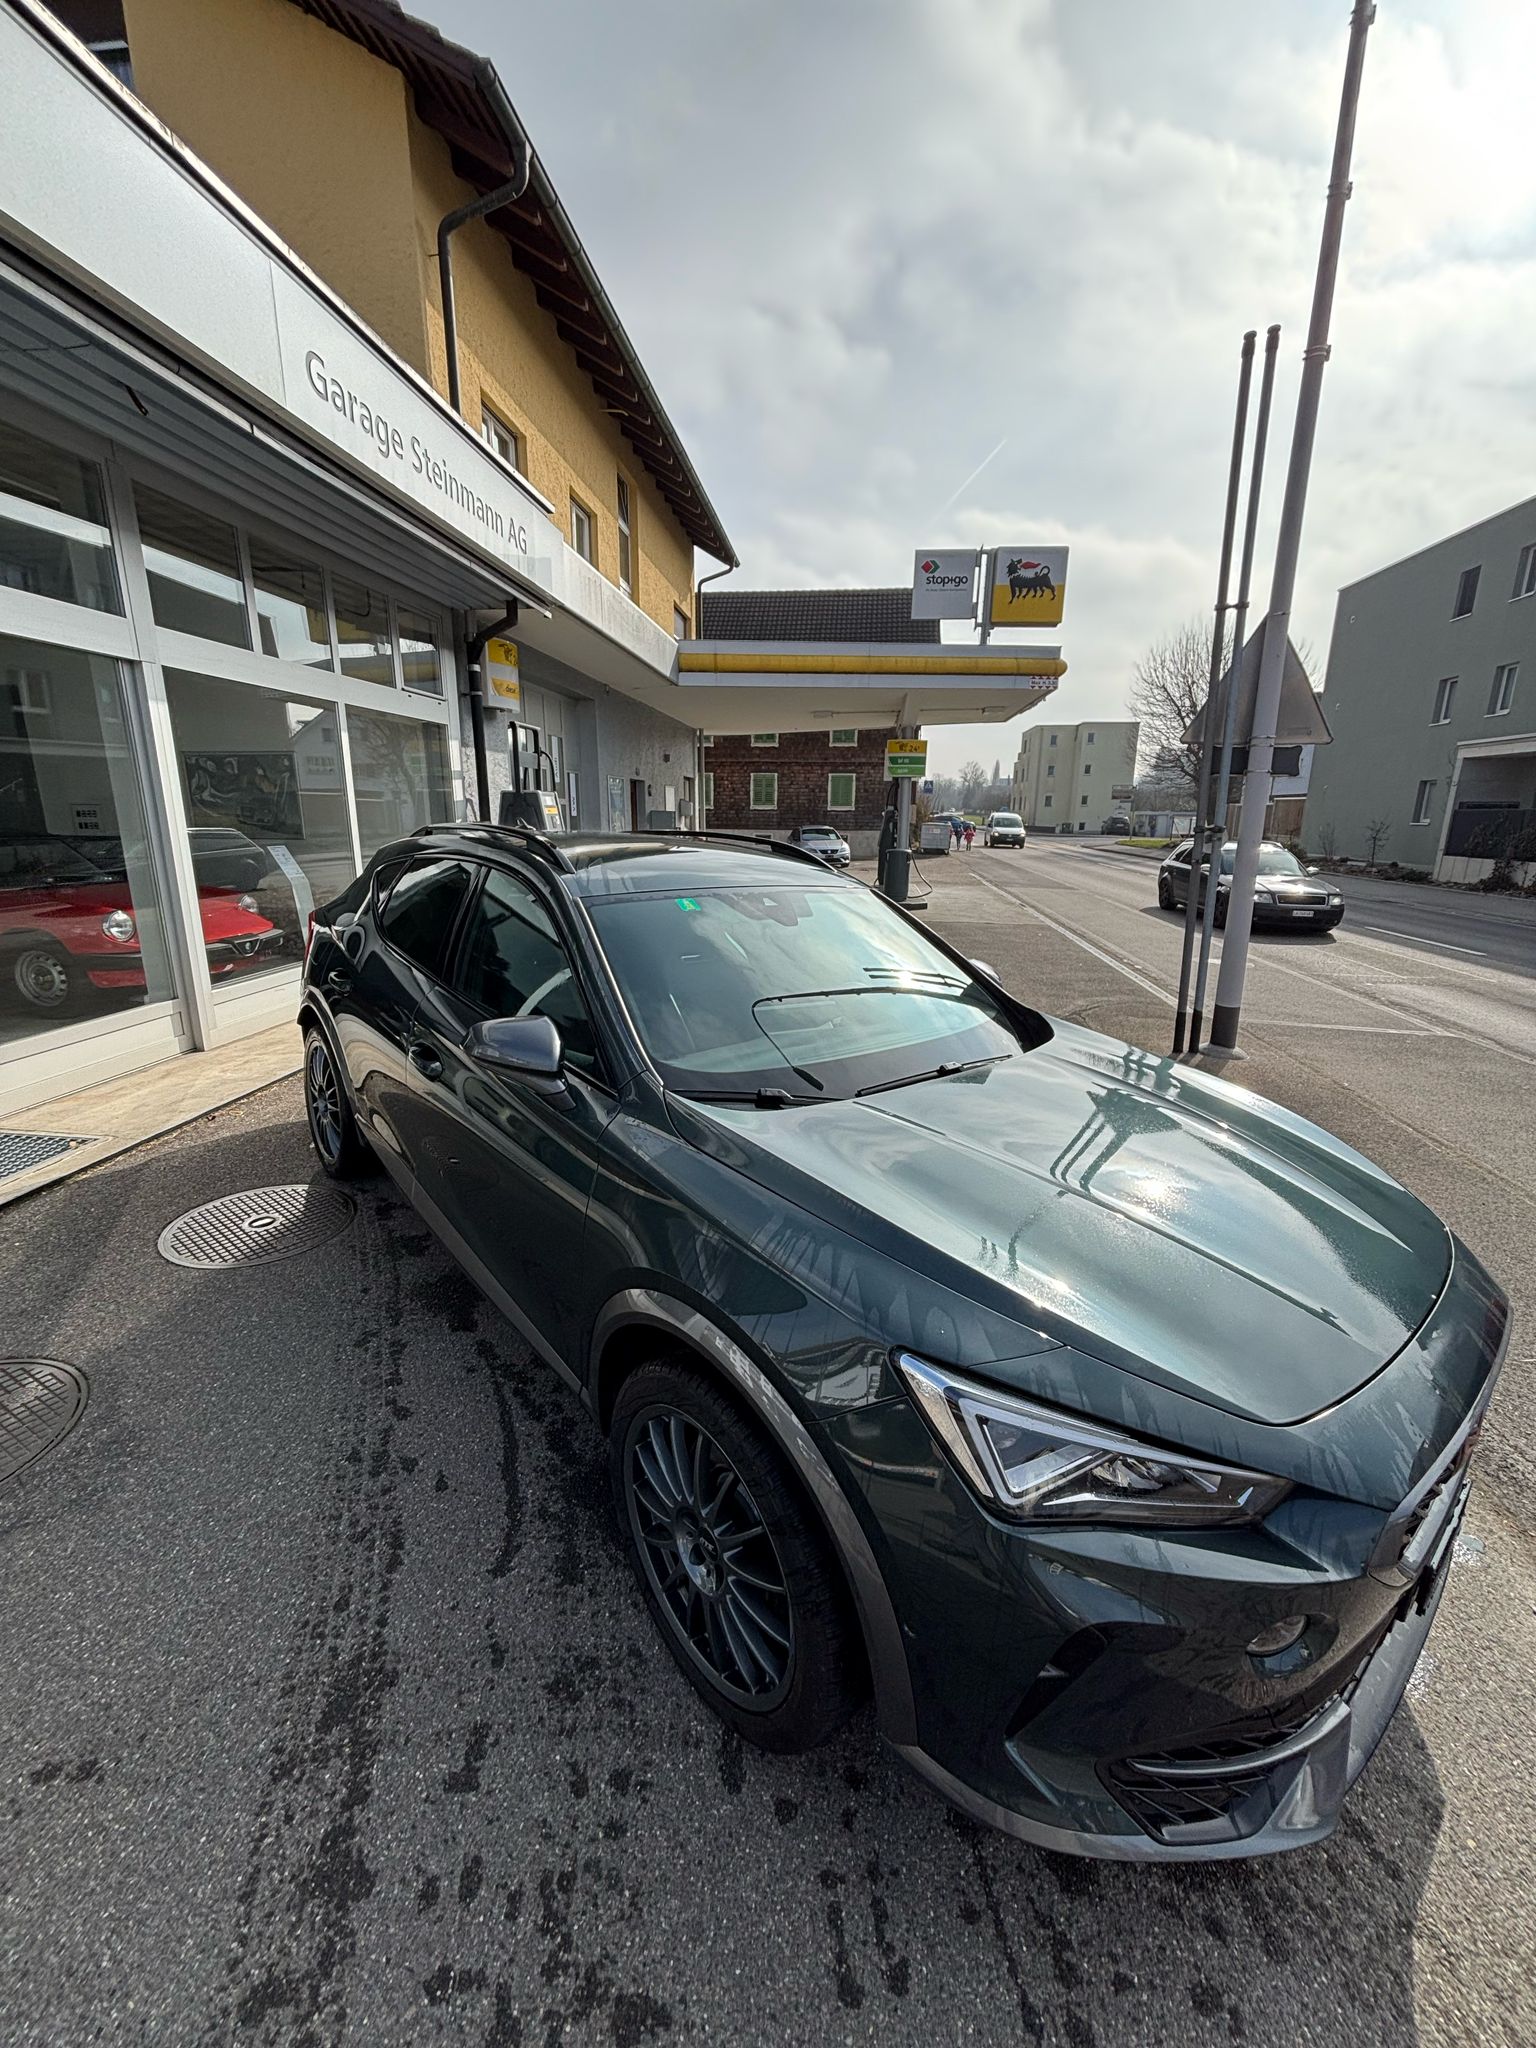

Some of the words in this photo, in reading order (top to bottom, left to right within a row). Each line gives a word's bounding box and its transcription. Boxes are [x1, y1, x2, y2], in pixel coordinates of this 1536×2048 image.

[305, 350, 404, 460] Garage
[410, 435, 504, 538] Steinmann
[508, 517, 528, 555] AG
[925, 575, 969, 587] stop+go
